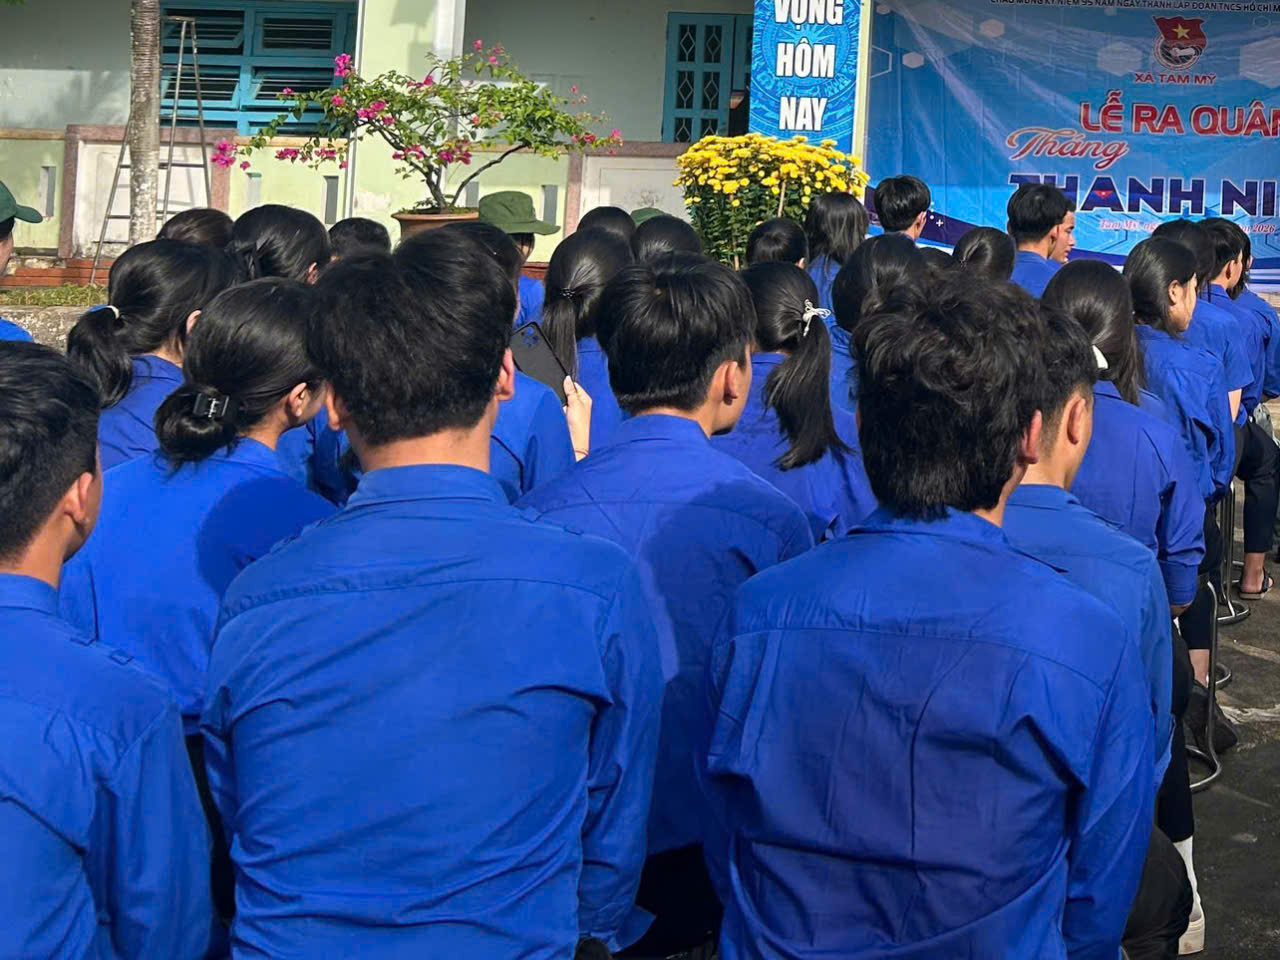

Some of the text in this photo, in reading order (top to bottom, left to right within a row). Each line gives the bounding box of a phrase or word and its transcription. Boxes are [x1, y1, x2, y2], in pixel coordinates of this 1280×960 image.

[1219, 2, 1242, 11] TNCS
[776, 38, 836, 79] HÔM
[1134, 72, 1216, 85] XÃ TAM MỸ
[778, 96, 828, 132] NAY
[1080, 88, 1124, 133] LỄ
[1131, 103, 1184, 135] RA
[1005, 126, 1129, 170] Tháng
